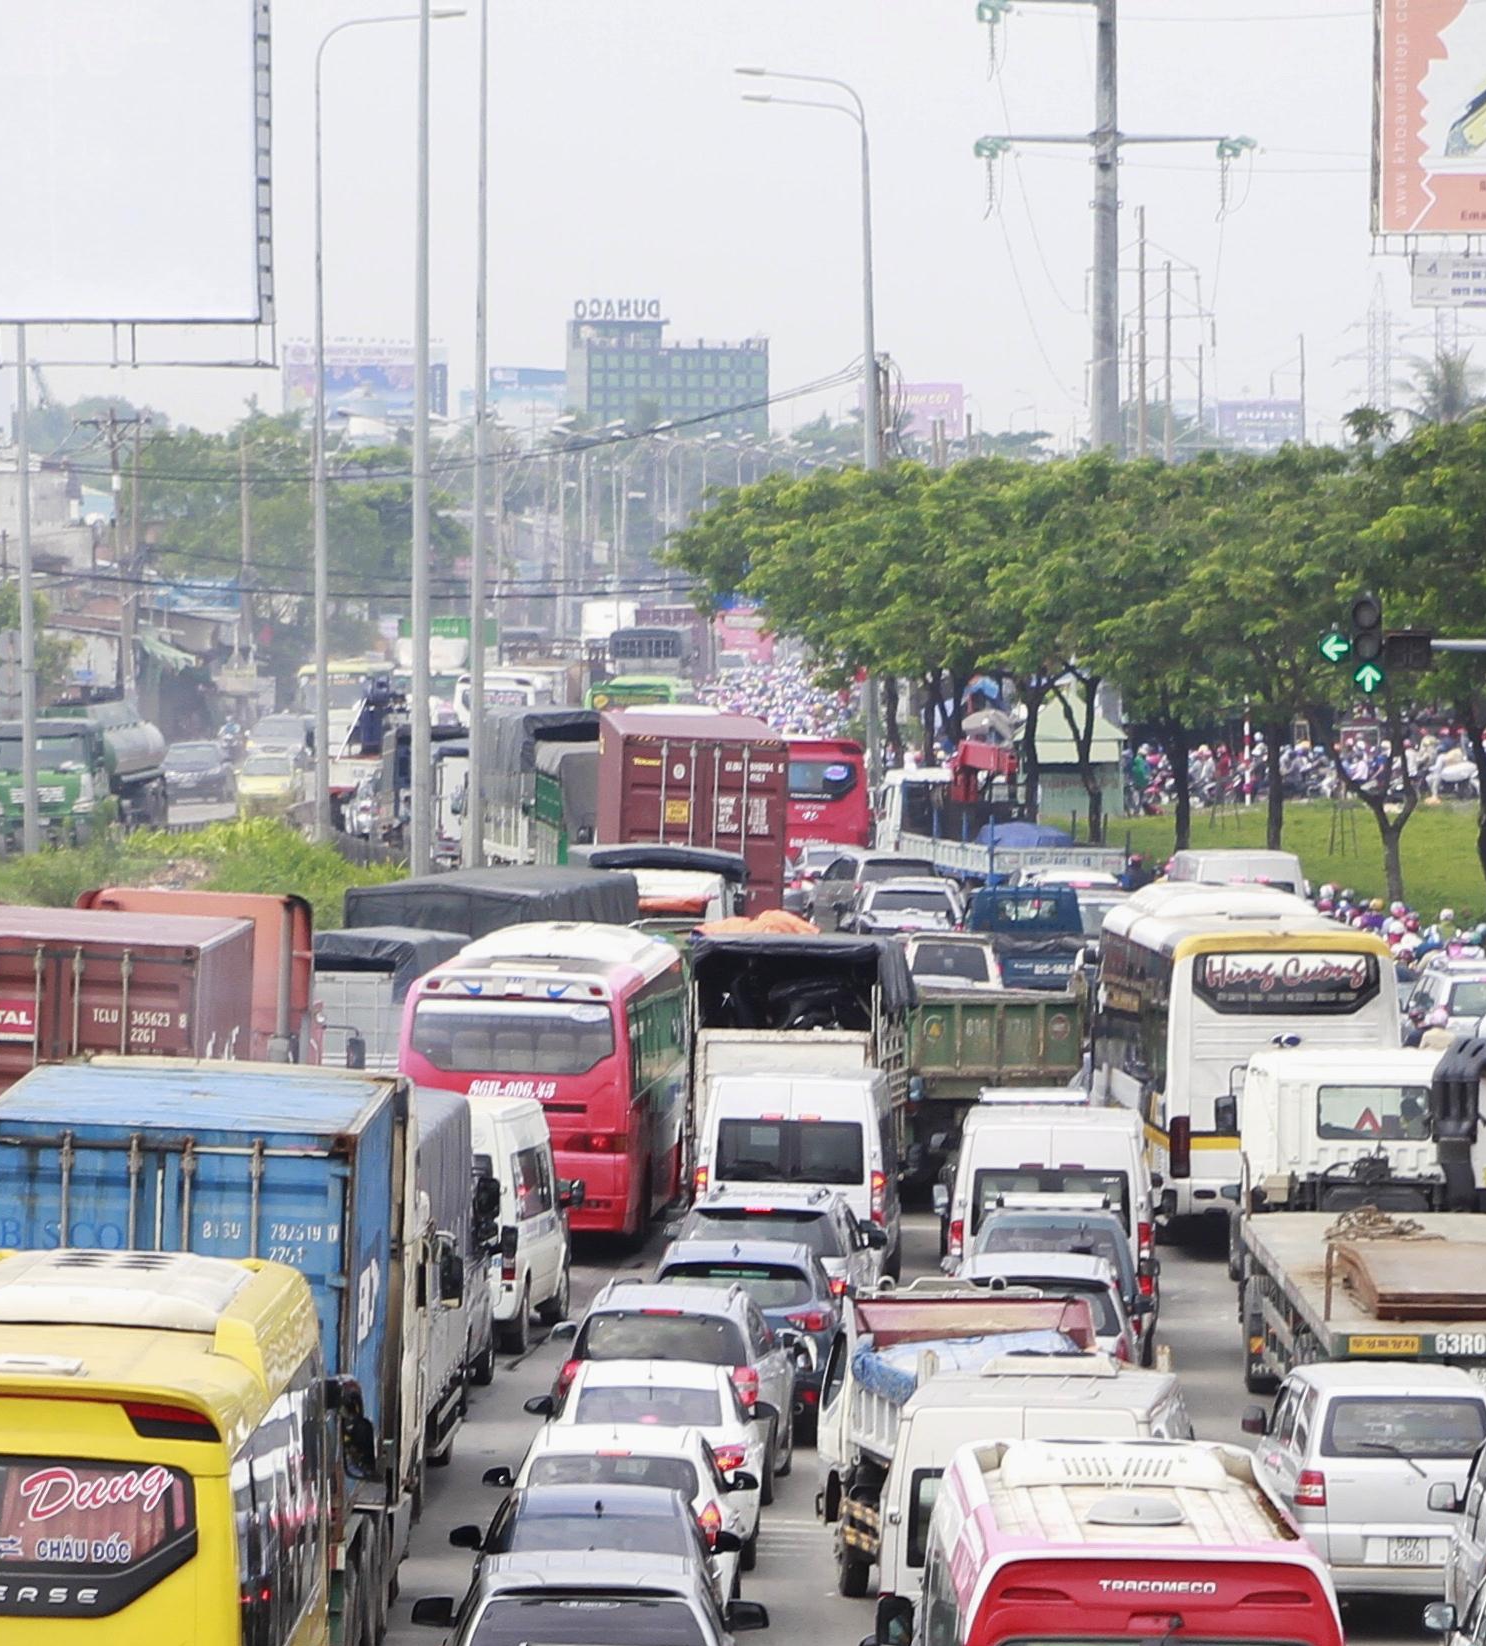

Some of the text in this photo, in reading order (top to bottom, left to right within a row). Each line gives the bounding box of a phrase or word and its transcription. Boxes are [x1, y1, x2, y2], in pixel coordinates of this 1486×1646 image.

[93, 1008, 119, 1024] TCLU
[19, 1464, 175, 1522] Dung
[35, 1534, 87, 1562] CHÂU
[90, 1532, 131, 1563] ĐỐC
[1098, 1579, 1218, 1594] TRACOMECO
